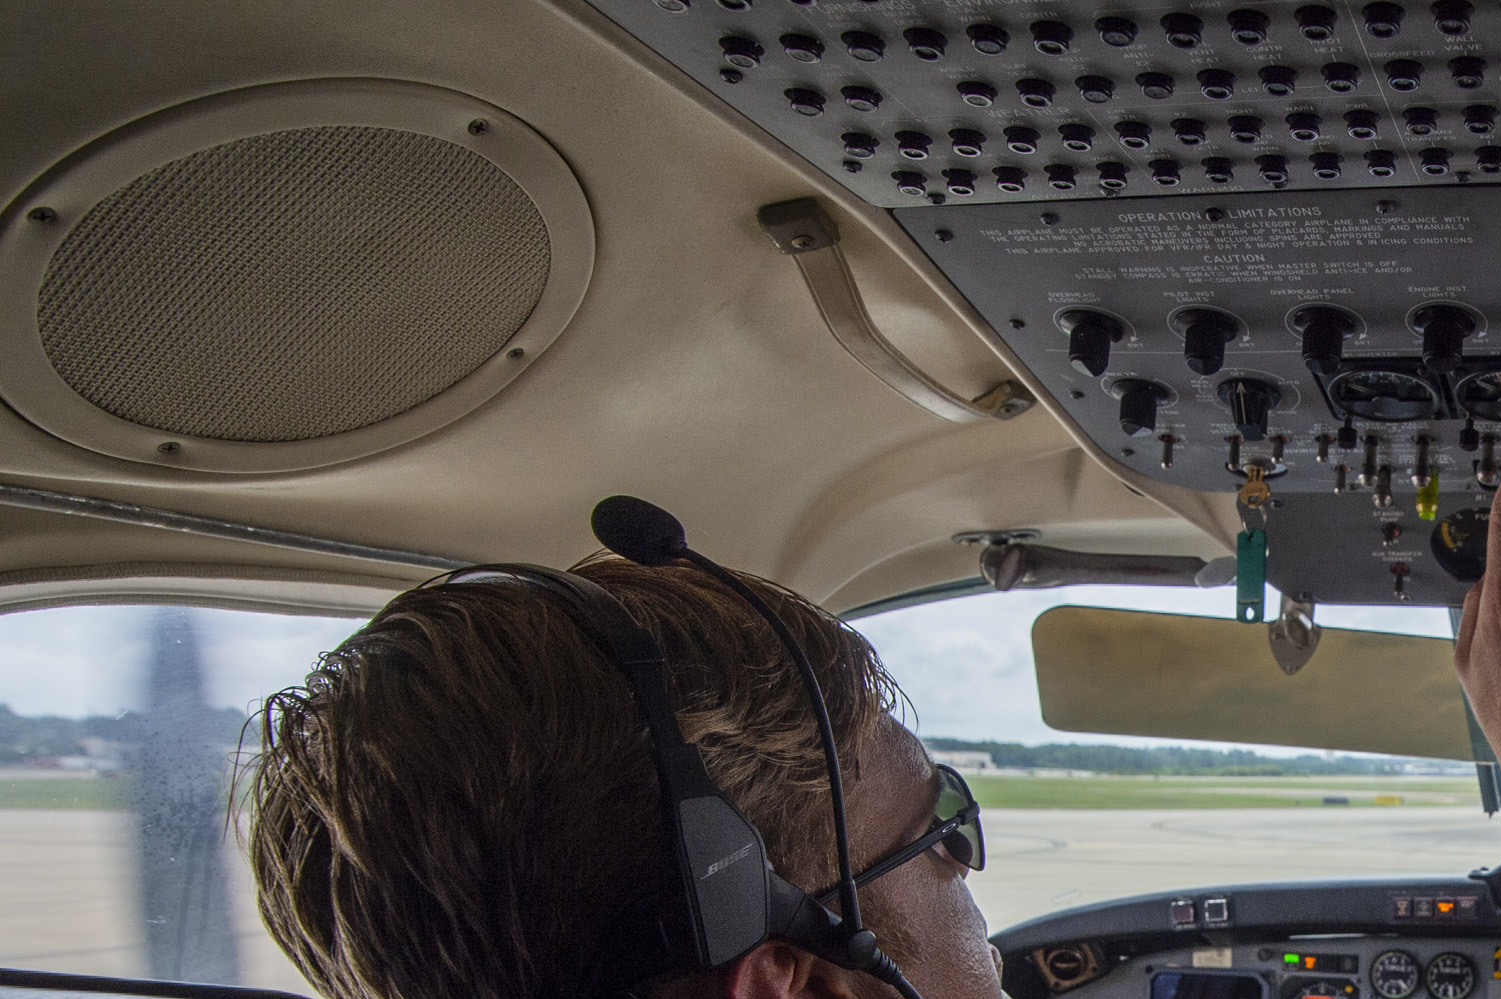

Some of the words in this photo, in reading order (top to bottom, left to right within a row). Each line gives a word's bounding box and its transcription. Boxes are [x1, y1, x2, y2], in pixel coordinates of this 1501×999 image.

[1369, 50, 1435, 58] CROSSFEED
[986, 107, 1070, 118] WEATHER
[1178, 184, 1244, 194] WARNING
[1119, 211, 1201, 223] OPERATION
[1228, 206, 1321, 218] LIMITATIONS
[1072, 233, 1132, 241] LIMITATIONS
[1272, 227, 1329, 235] PLACARDS,
[1334, 225, 1383, 233] MARKINGS
[1170, 243, 1211, 251] VFR/IFR
[1203, 254, 1265, 263] CAUTION
[1180, 264, 1241, 272] INOPERATIVE
[1234, 269, 1257, 277] WHEN
